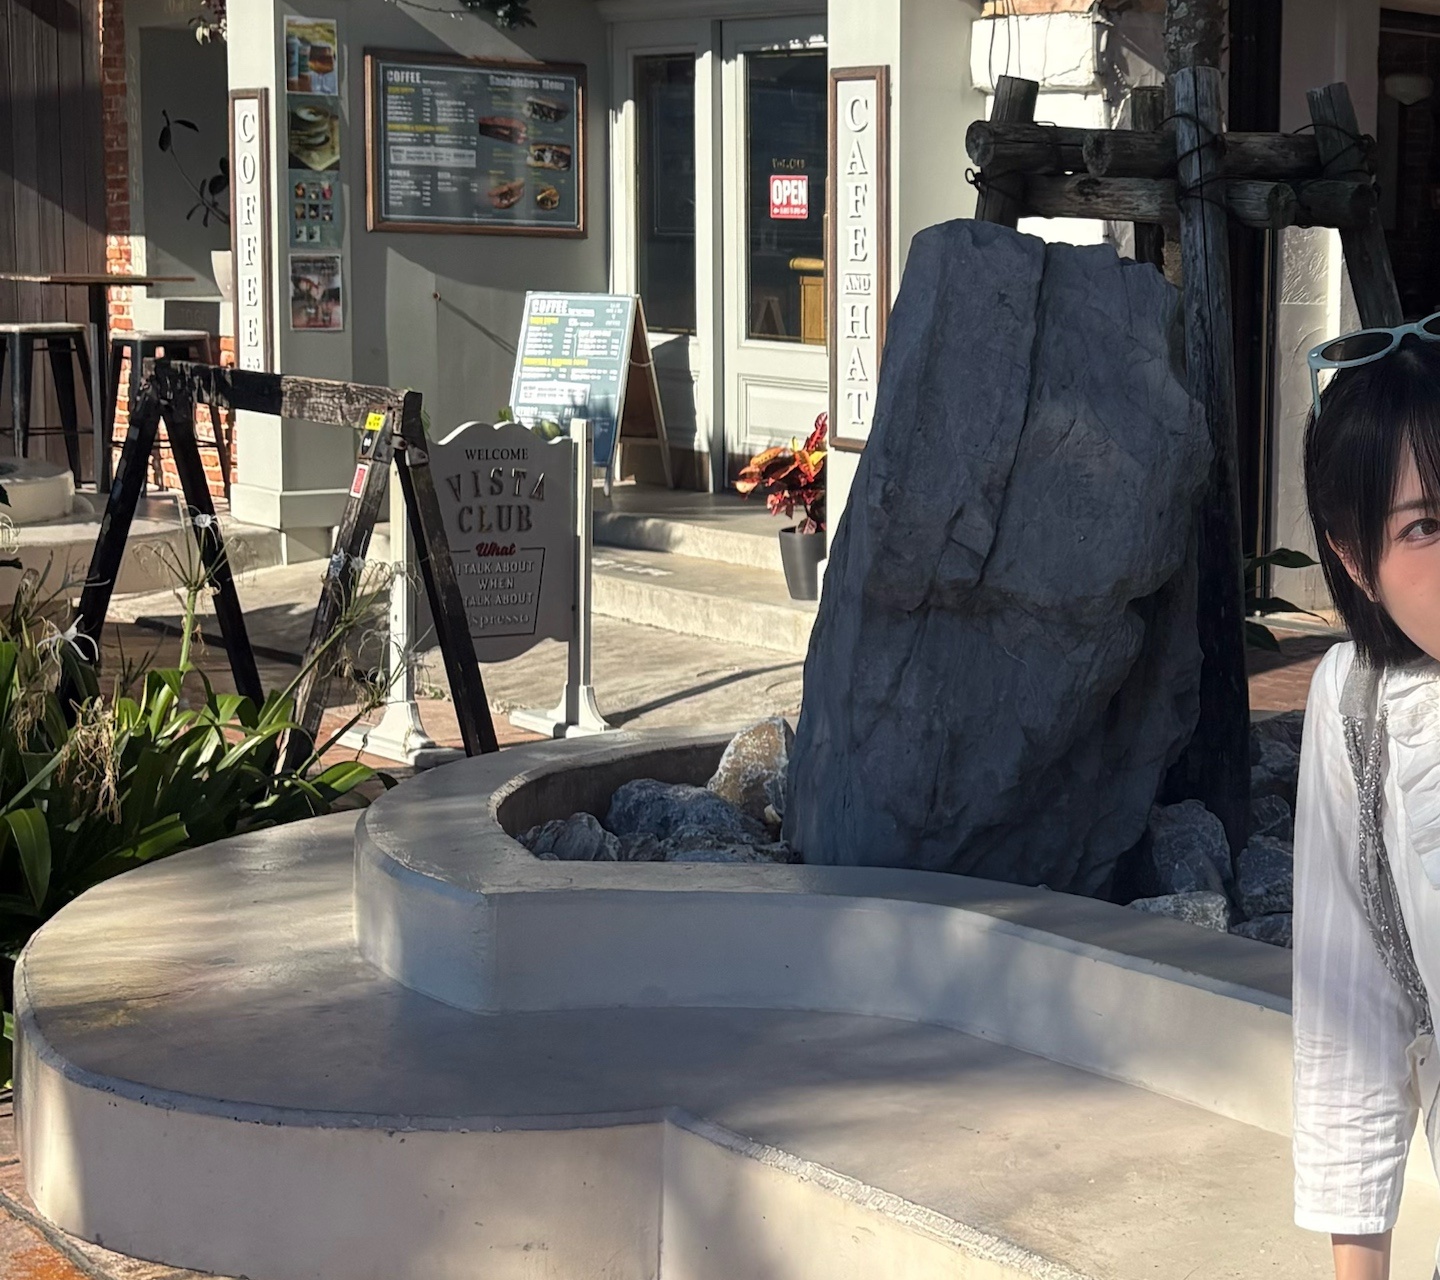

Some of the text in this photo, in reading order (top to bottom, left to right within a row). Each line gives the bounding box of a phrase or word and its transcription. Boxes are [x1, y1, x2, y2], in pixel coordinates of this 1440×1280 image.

[386, 70, 421, 84] COFFEE
[772, 179, 807, 206] OPEN
[238, 110, 260, 348] COFFEE
[843, 93, 872, 426] CAFE AND HAT
[531, 299, 568, 315] COFFEE
[465, 448, 529, 461] WELCOME
[446, 467, 545, 503] VISTA
[458, 504, 533, 535] CLUB
[475, 541, 516, 558] What
[463, 562, 492, 576] TALK
[495, 561, 534, 573] ABOUT
[478, 577, 515, 591] WHEN
[494, 592, 534, 606] ABOUT
[470, 613, 530, 629] spresso
